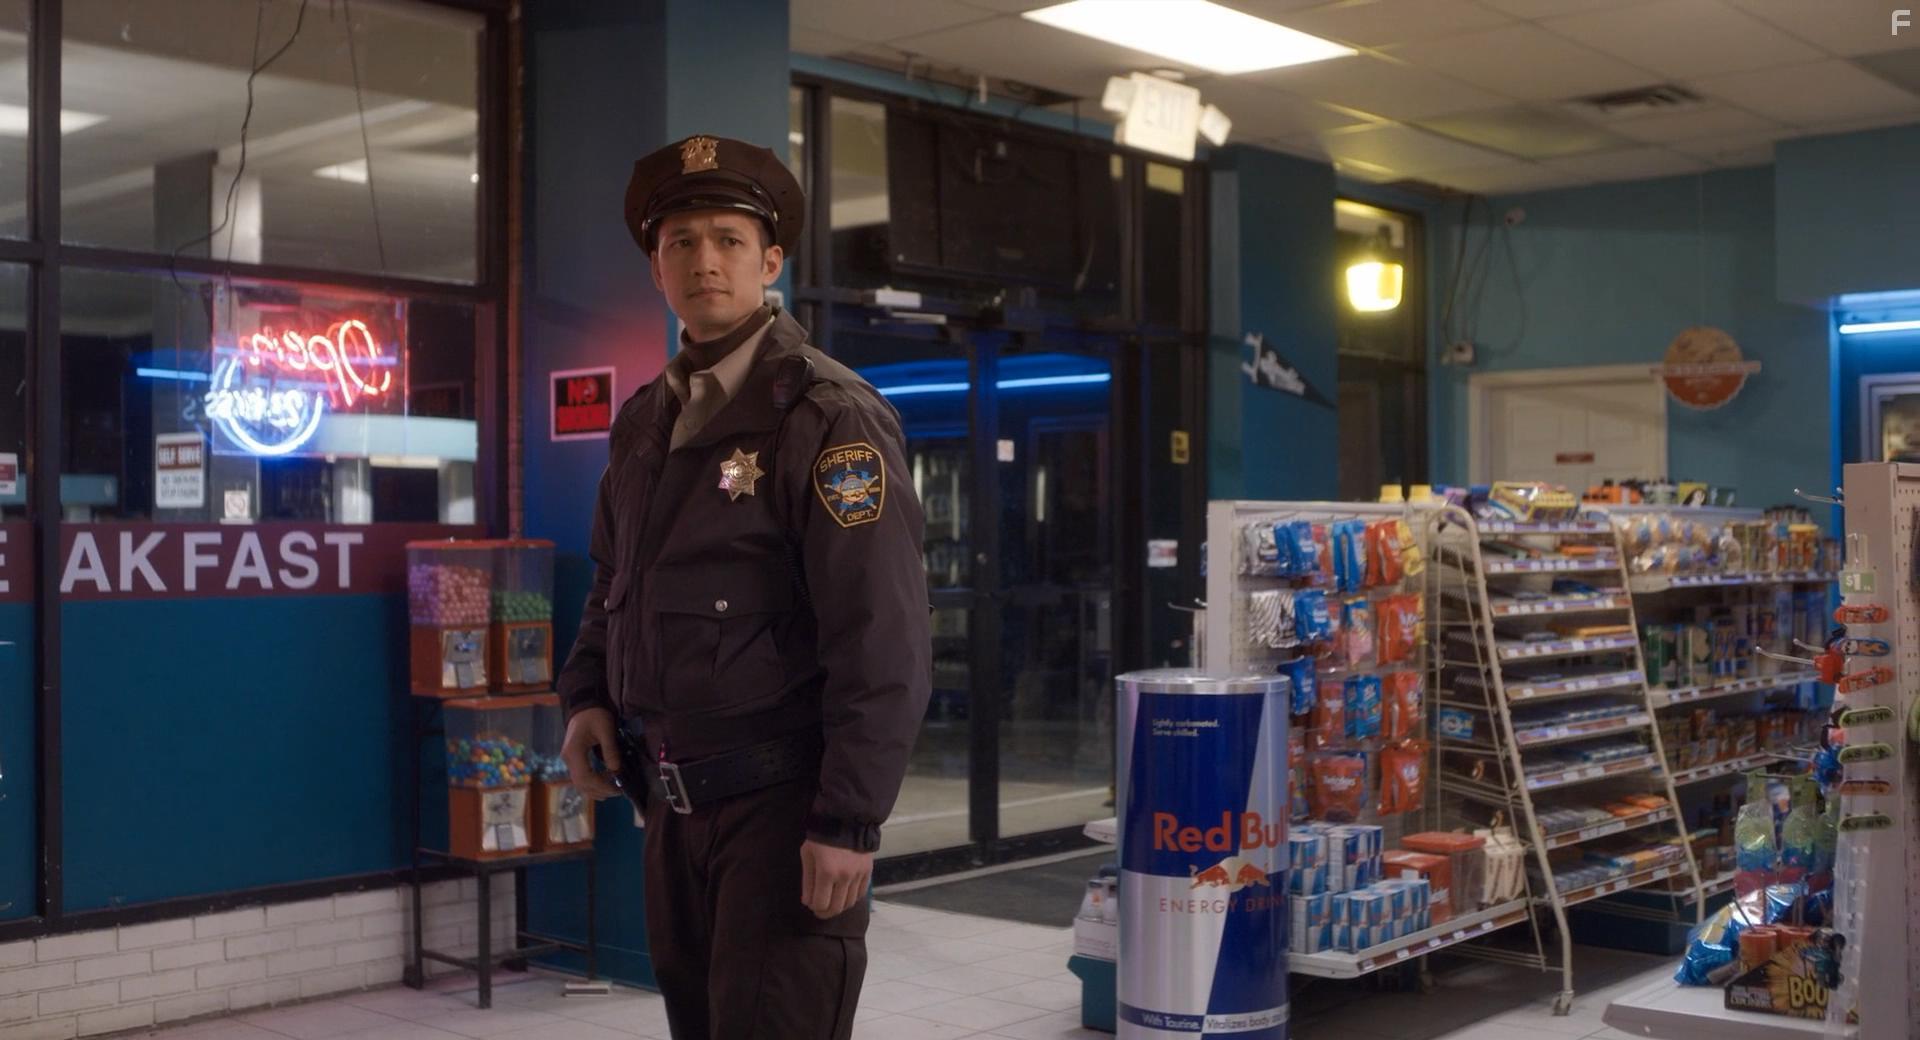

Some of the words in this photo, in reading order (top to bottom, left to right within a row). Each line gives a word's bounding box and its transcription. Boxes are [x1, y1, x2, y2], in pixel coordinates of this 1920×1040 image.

[820, 449, 873, 473] SHERIFF
[0, 531, 364, 593] AKFAST
[1153, 811, 1232, 852] Red
[1160, 898, 1238, 914] ENERGY
